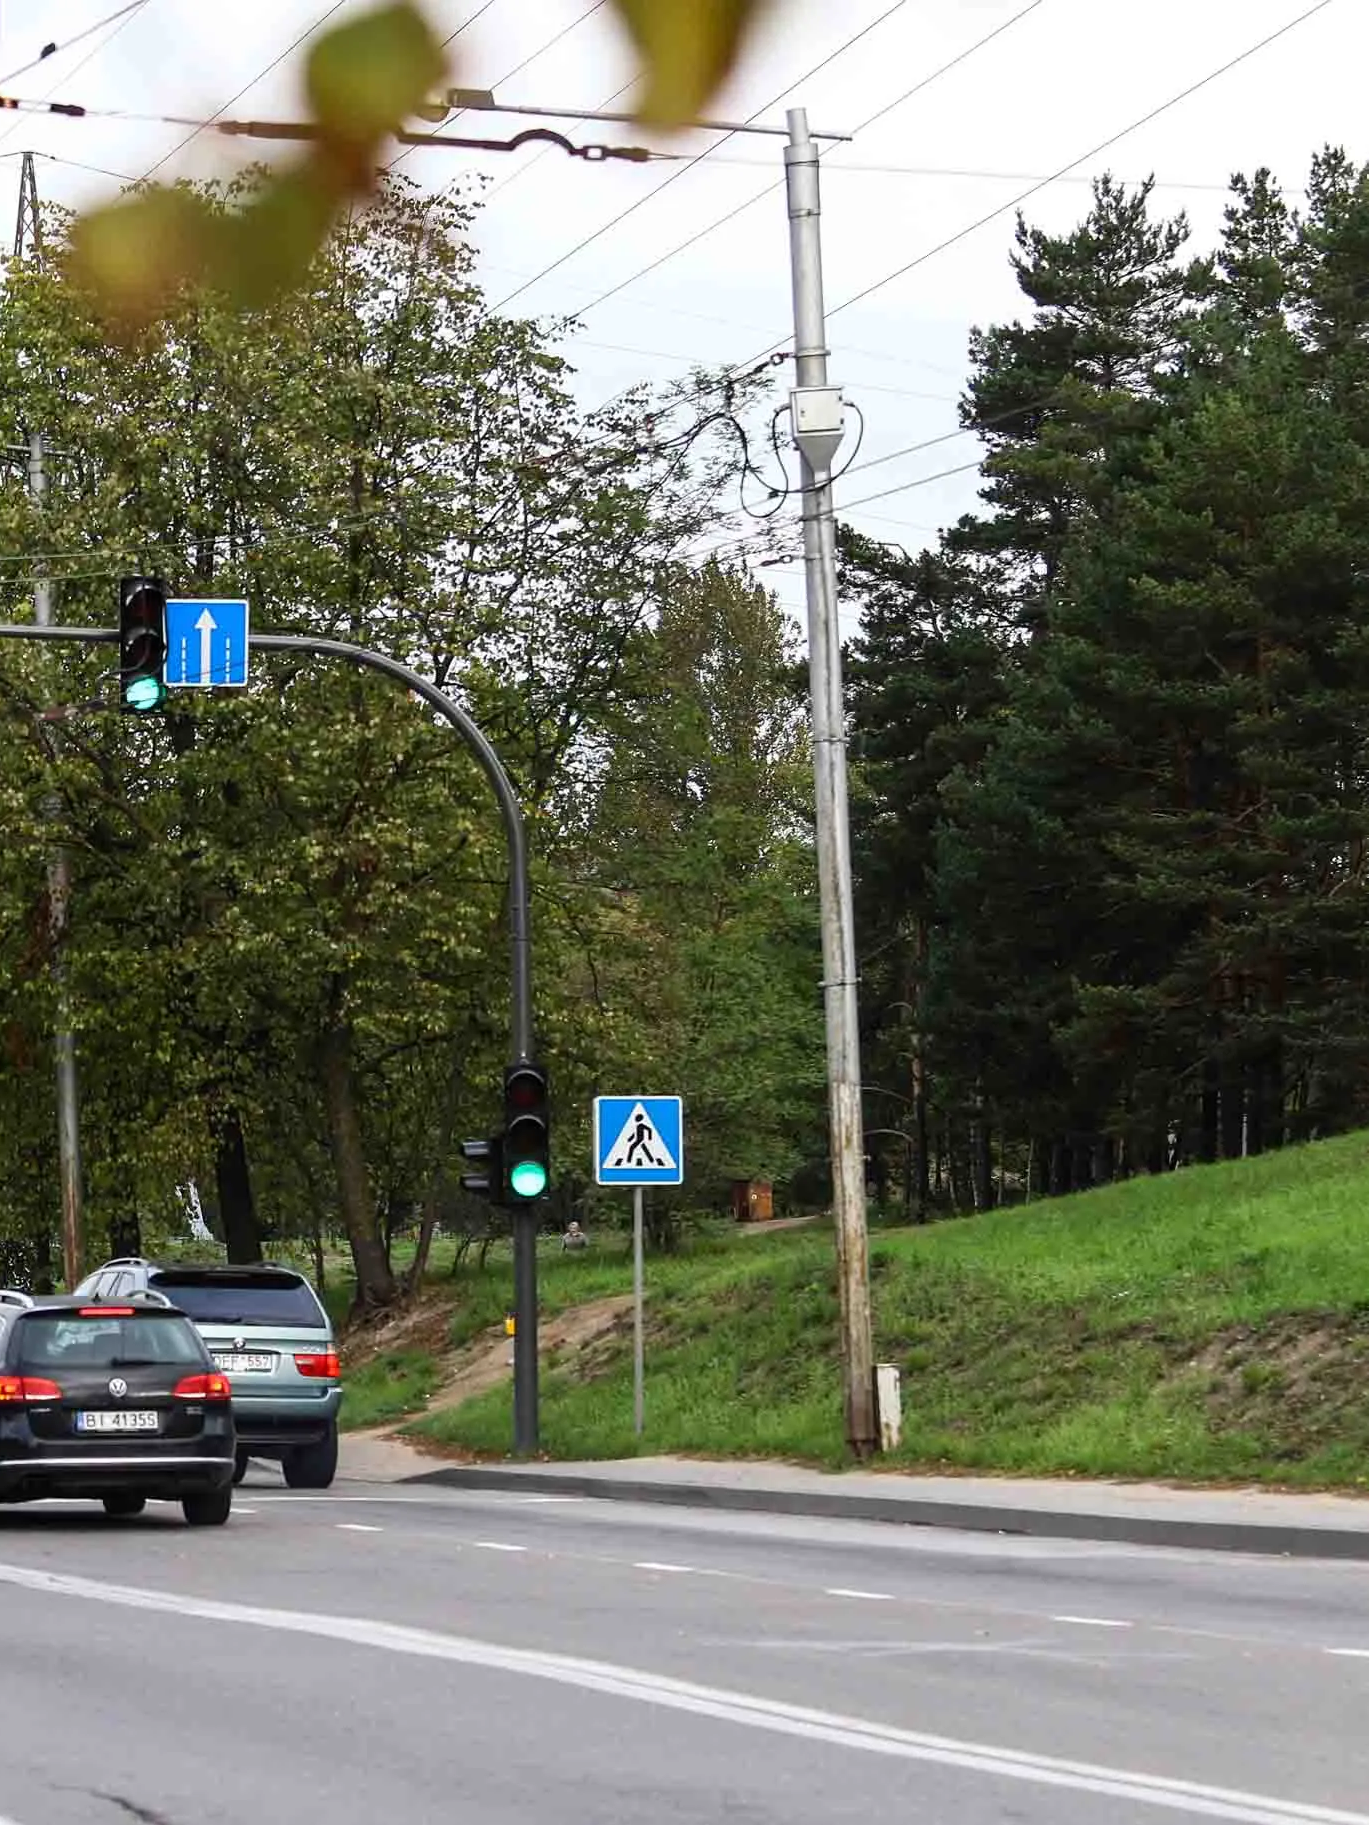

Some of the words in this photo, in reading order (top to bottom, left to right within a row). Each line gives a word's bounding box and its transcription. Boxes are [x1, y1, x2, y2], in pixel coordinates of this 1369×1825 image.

[247, 1355, 269, 1367] 557
[86, 1414, 103, 1427] BI
[112, 1413, 156, 1427] 41355
